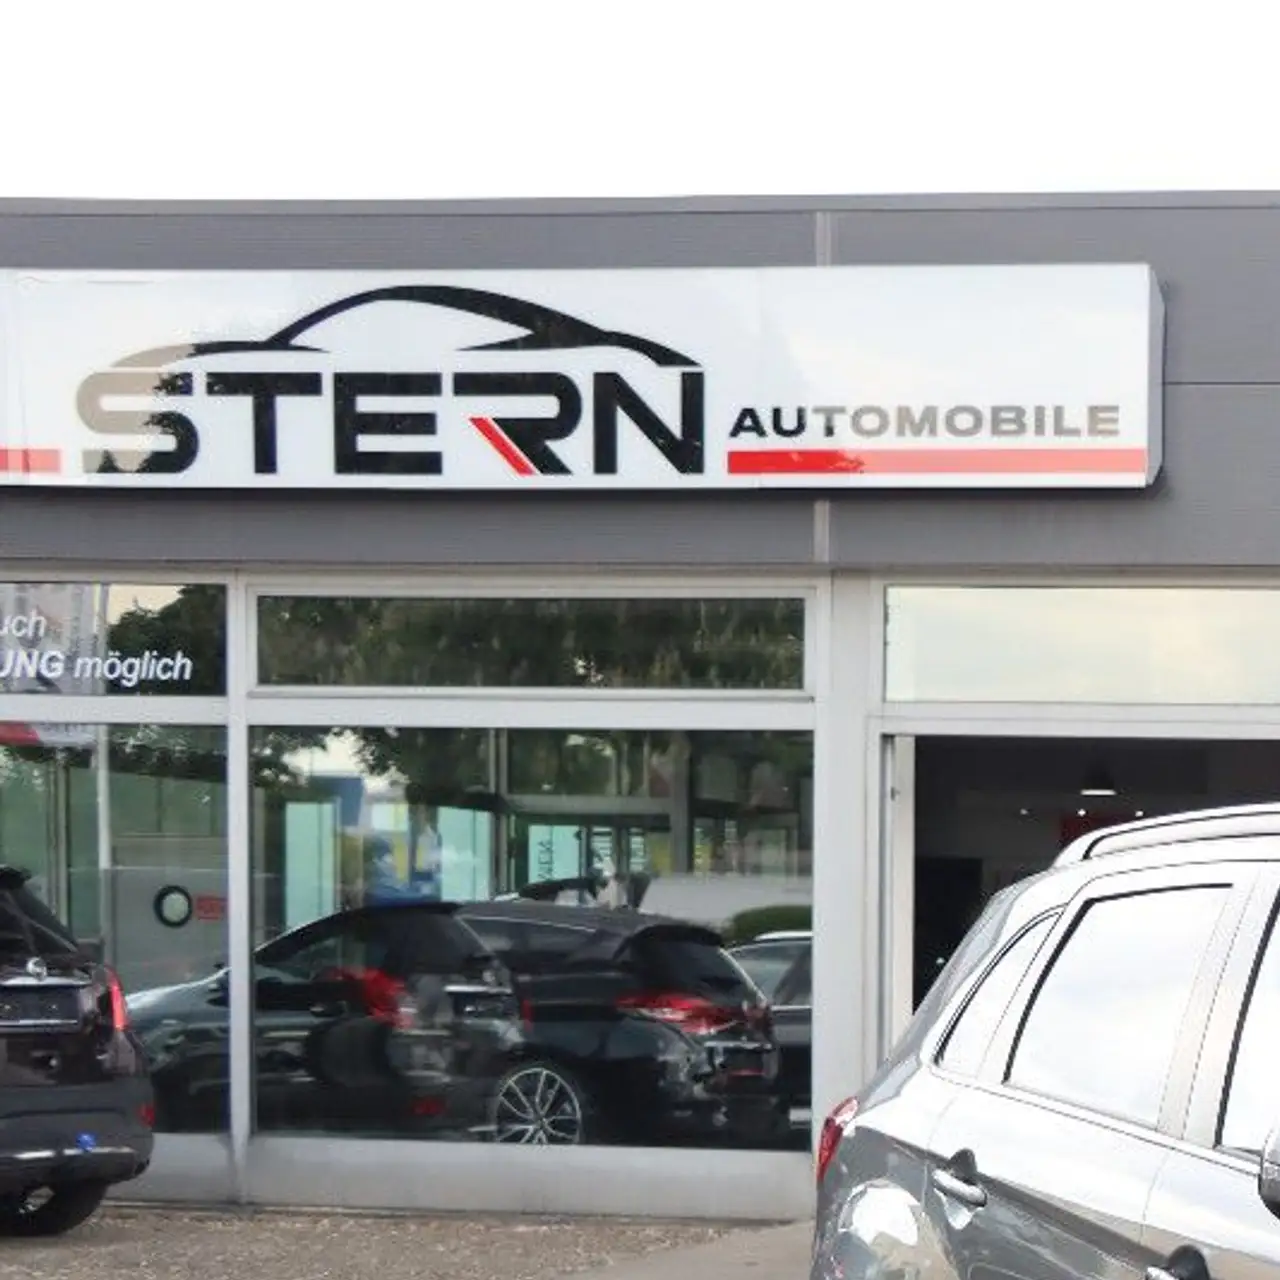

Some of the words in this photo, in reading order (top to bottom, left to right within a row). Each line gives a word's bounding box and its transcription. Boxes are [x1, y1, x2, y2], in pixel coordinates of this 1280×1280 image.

[76, 371, 705, 475] STERN
[729, 405, 1121, 439] AUTOMOBILE
[74, 650, 193, 687] möglich
